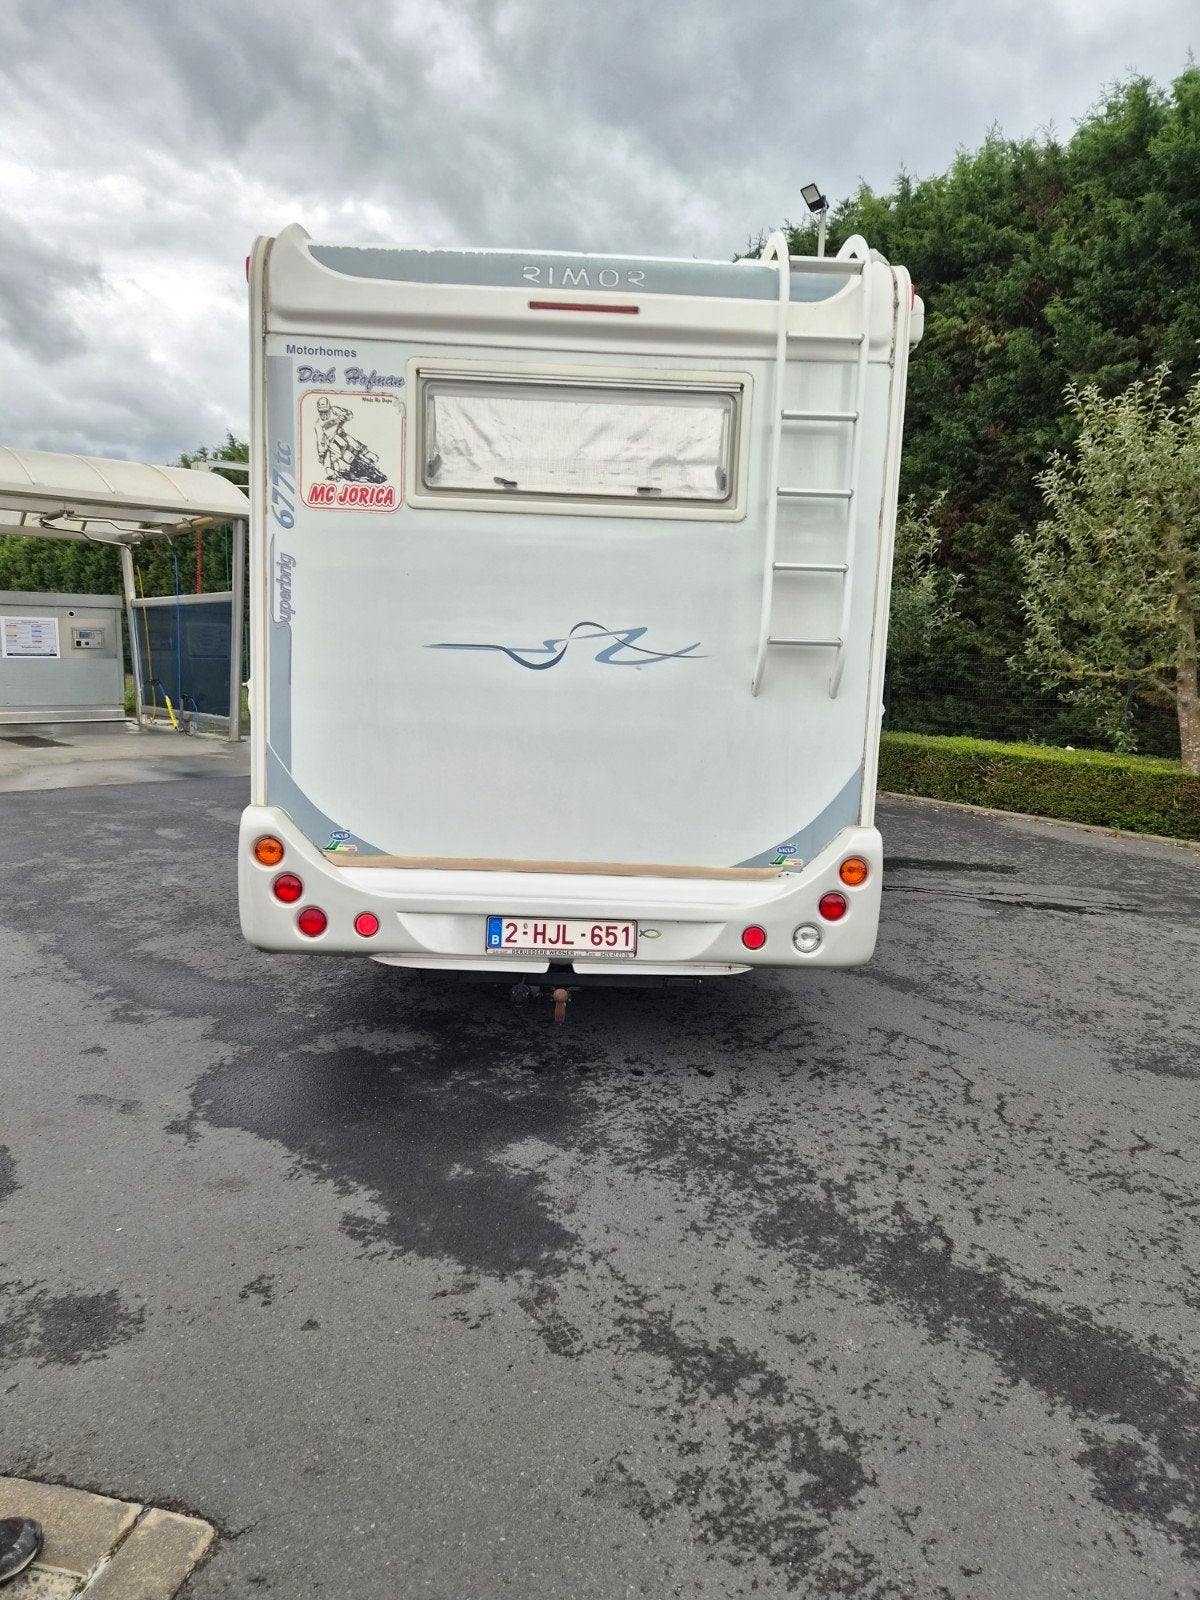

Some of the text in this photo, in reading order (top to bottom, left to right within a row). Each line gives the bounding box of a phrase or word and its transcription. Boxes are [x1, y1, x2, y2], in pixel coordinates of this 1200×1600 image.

[523, 266, 645, 287] RIMOR
[286, 344, 357, 358] Motorhomes
[297, 364, 405, 391] Dirk Hofman
[272, 469, 295, 529] 677
[308, 484, 395, 506] MC JORICA
[491, 922, 630, 947] B 2-HJL-651
